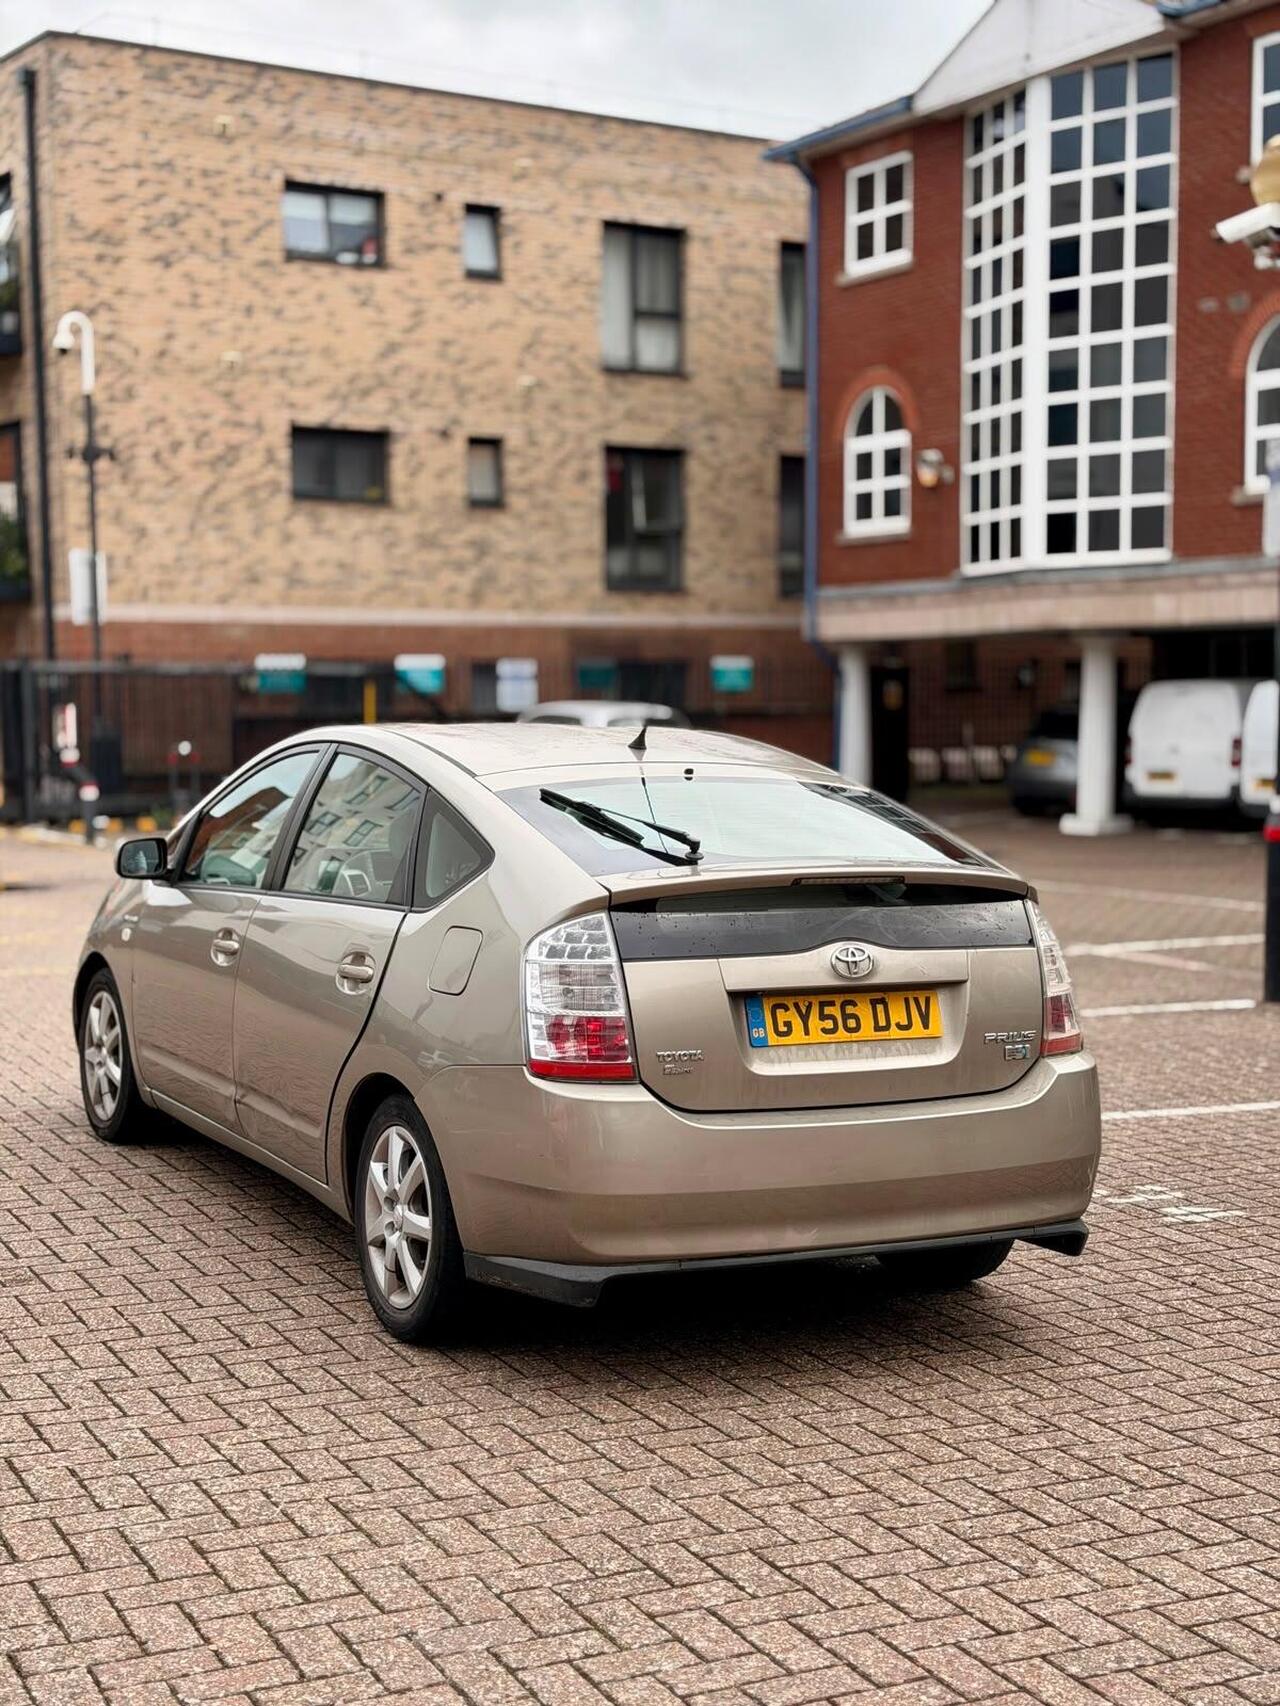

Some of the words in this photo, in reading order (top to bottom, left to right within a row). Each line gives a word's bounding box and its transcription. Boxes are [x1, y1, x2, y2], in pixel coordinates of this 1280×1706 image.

[770, 1001, 861, 1038] GY56
[868, 995, 931, 1033] DJV
[752, 1027, 765, 1038] GB
[983, 1030, 1036, 1044] PRIUS
[655, 1050, 704, 1062] TOYOTA
